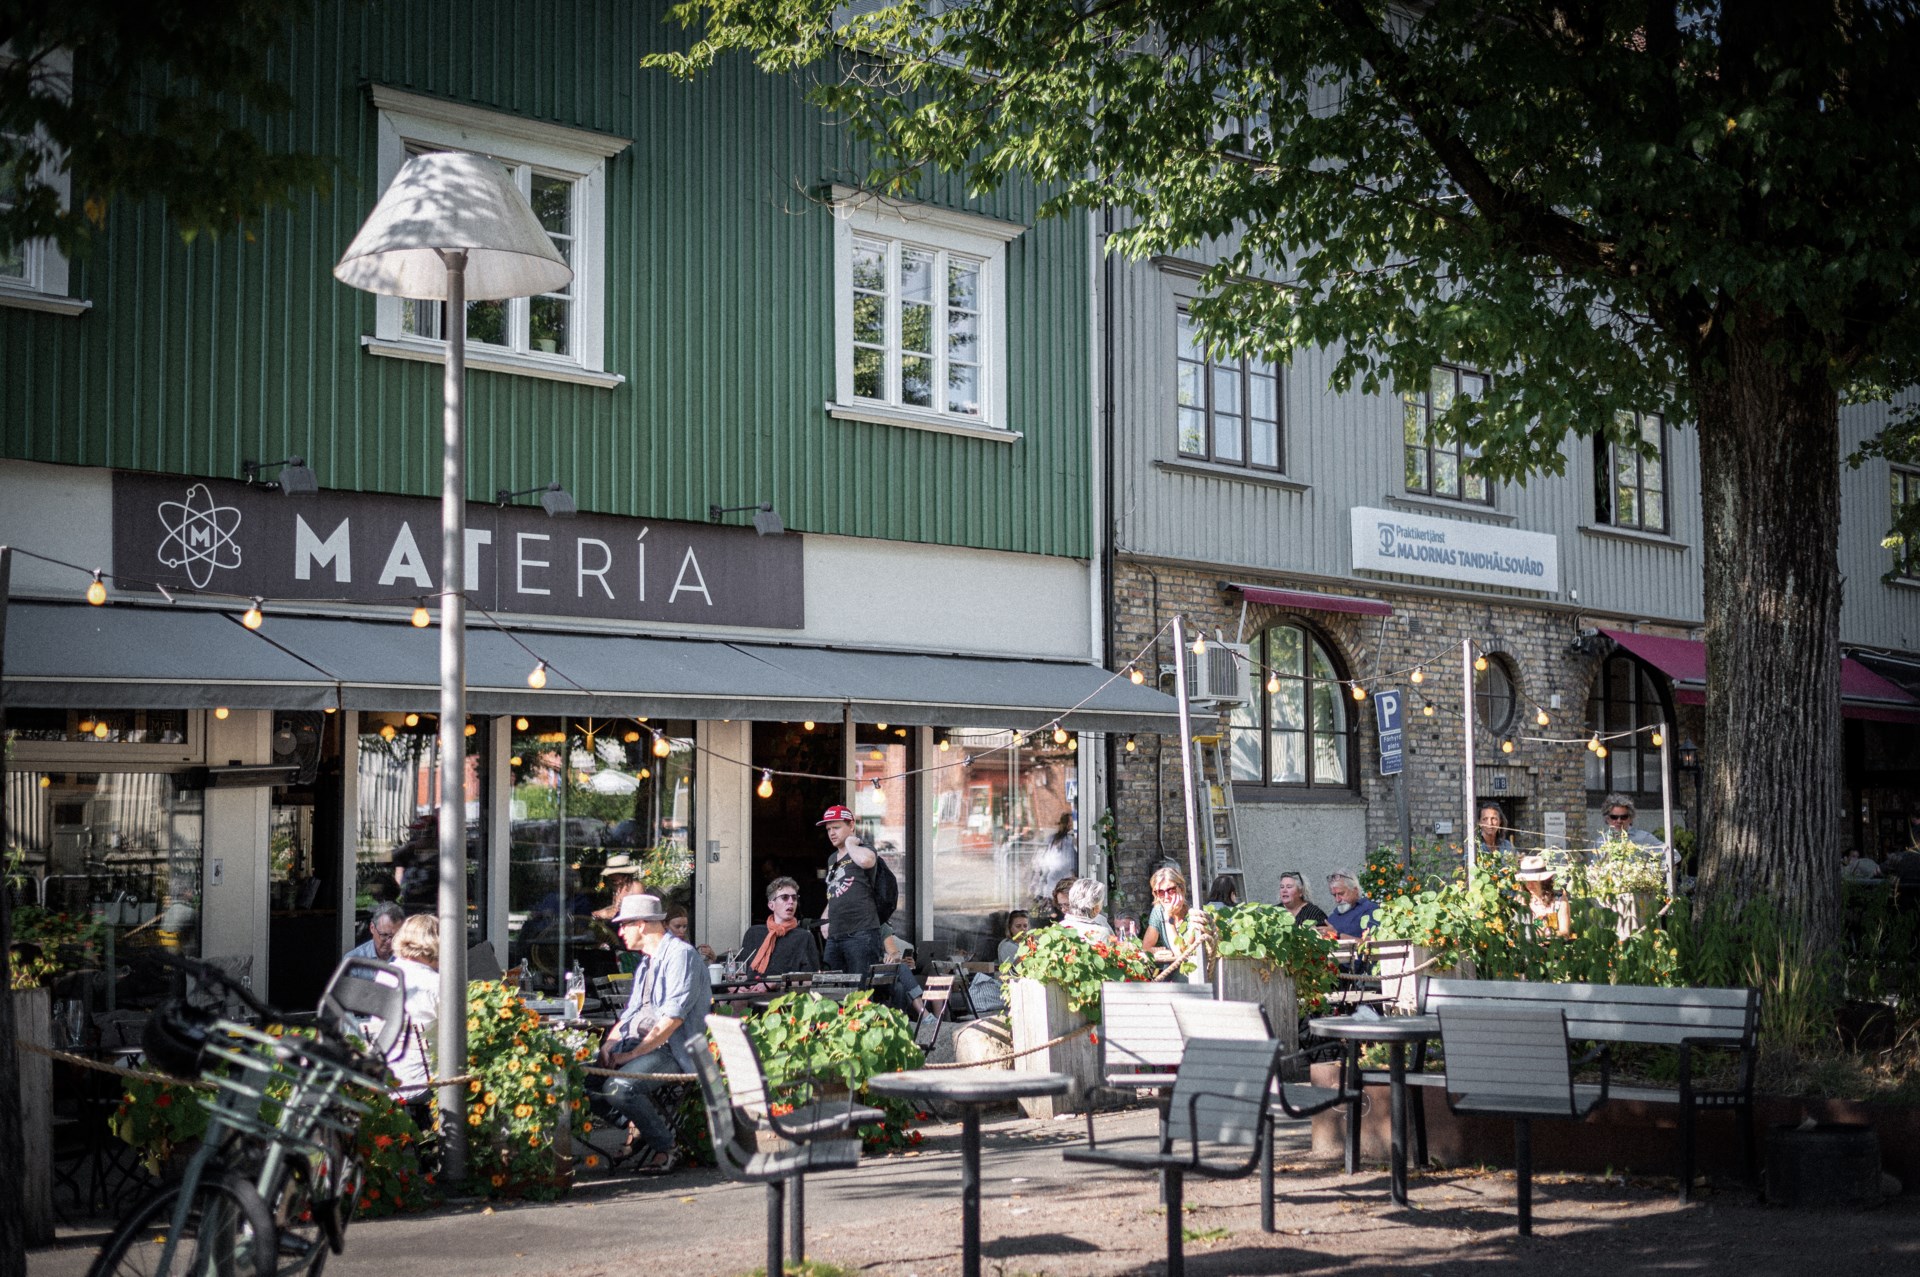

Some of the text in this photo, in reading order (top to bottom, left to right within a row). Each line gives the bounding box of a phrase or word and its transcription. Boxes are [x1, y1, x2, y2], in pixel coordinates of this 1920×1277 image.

[190, 525, 211, 548] M
[1396, 525, 1445, 543] Praktikertjänst
[295, 514, 713, 606] MATERÍA
[1397, 542, 1544, 577] MAJORNAS TANDHÄLSOVÅRD
[1382, 695, 1397, 728] P
